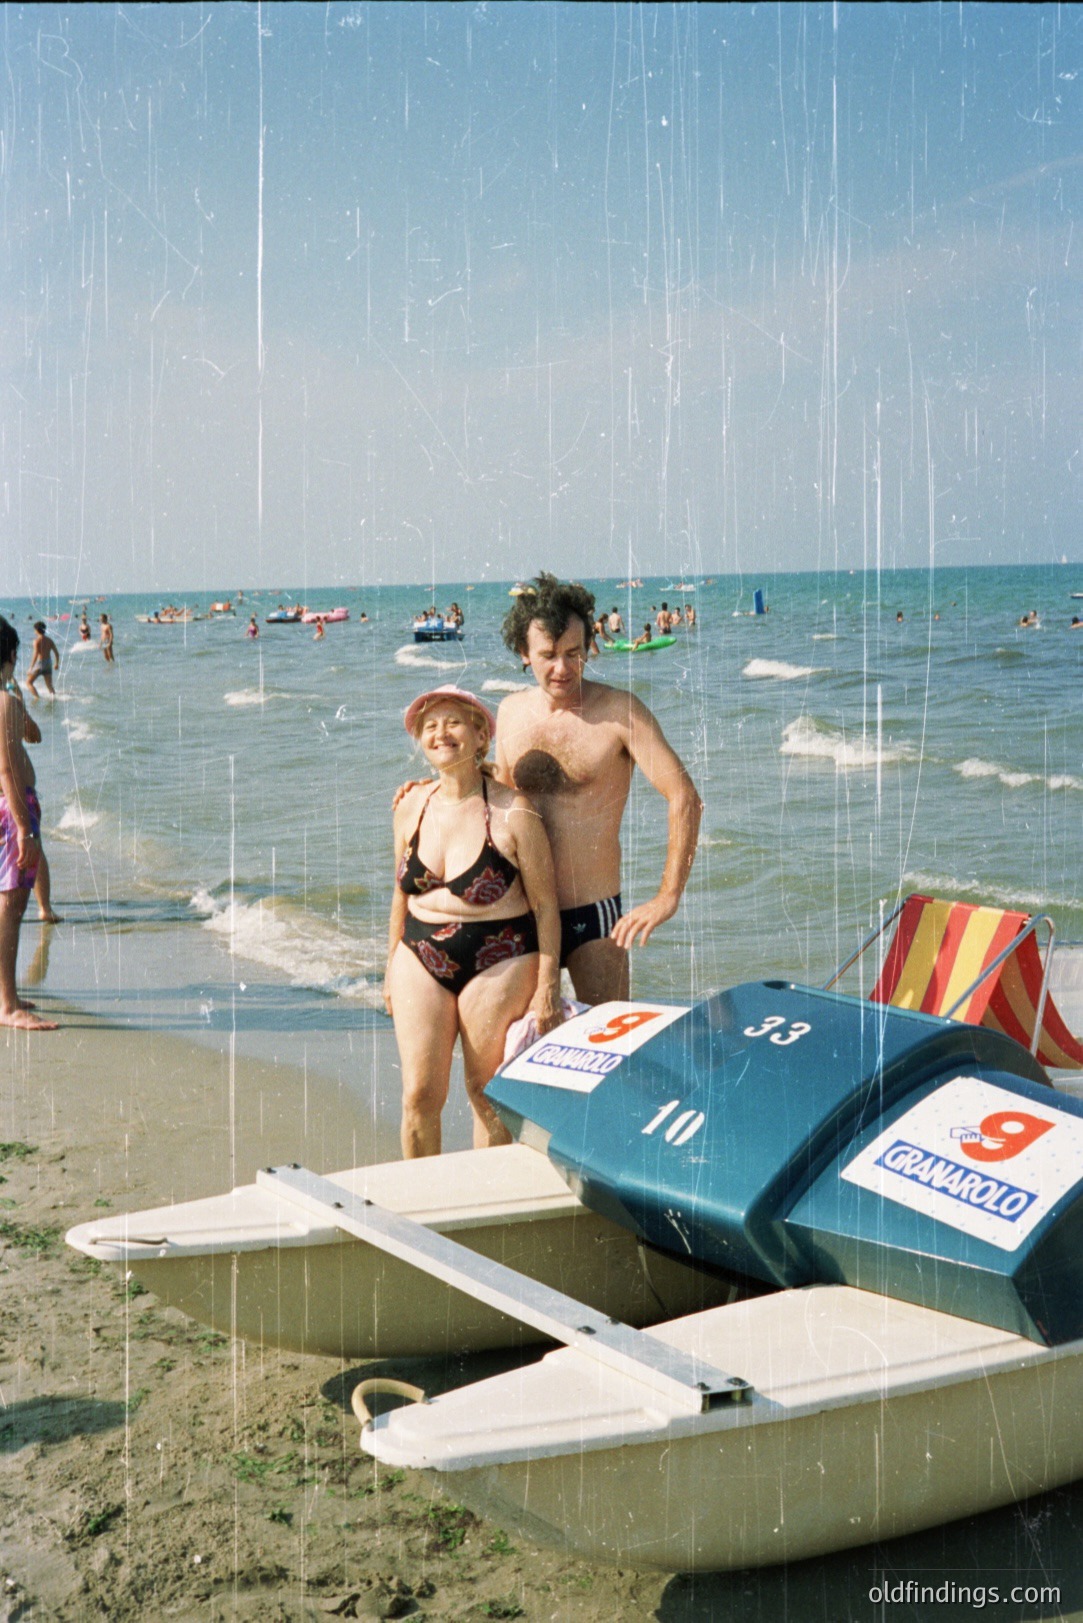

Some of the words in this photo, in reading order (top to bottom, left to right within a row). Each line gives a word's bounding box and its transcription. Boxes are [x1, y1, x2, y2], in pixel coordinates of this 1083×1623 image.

[743, 1015, 812, 1046] 33
[532, 1045, 624, 1074] GRANAROLO
[641, 1099, 705, 1146] 10
[883, 1145, 1029, 1217] GRANAROLO
